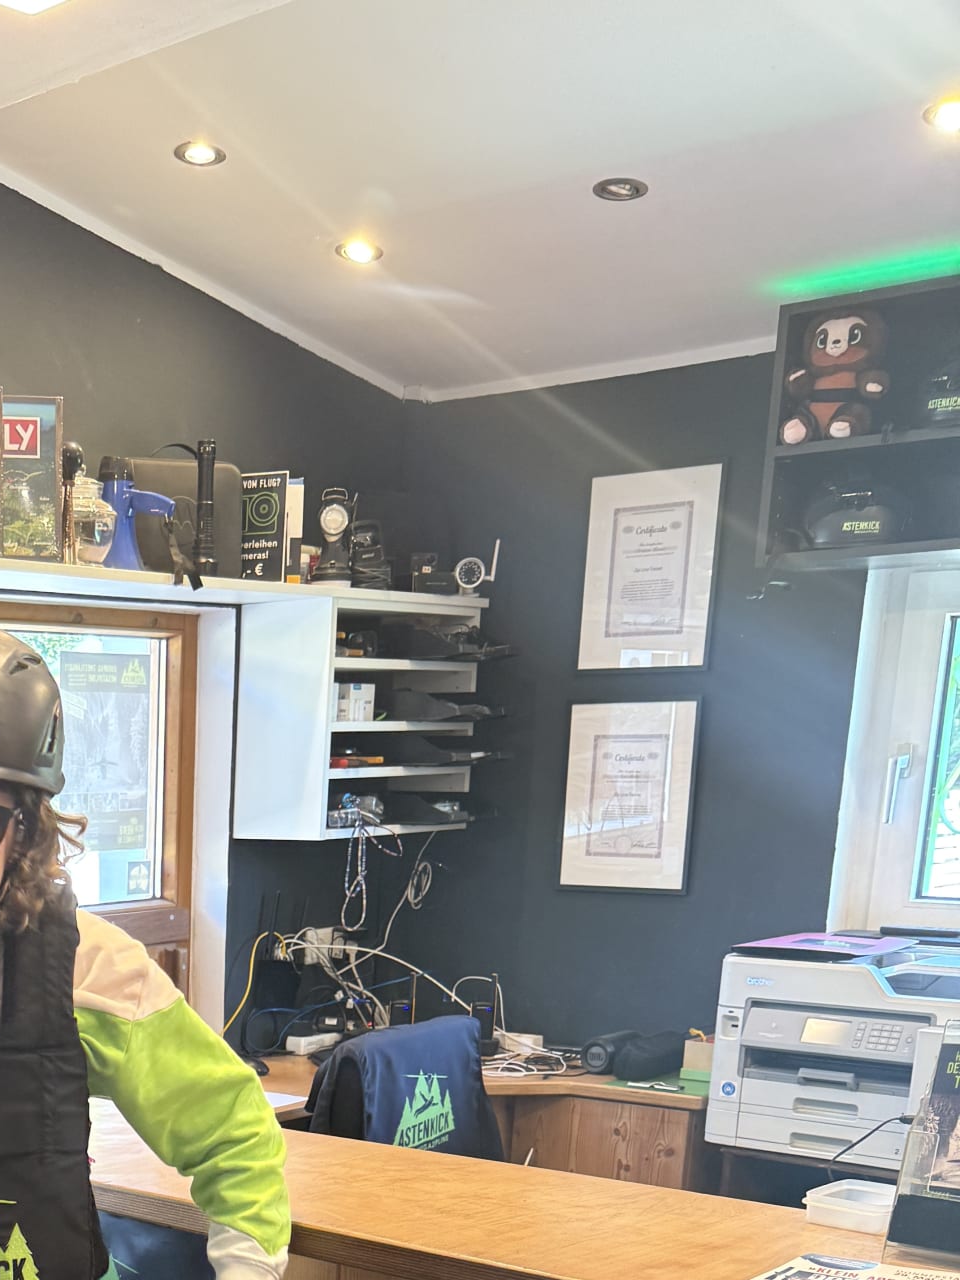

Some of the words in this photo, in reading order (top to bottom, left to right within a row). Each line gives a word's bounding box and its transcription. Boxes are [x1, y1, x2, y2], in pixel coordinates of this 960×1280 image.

[4, 423, 34, 451] LY
[259, 478, 281, 488] FLUG?
[842, 521, 880, 531] ASTENKICK
[242, 540, 278, 549] erleihen
[254, 562, 264, 576] €
[399, 1111, 449, 1147] ASTENKICK
